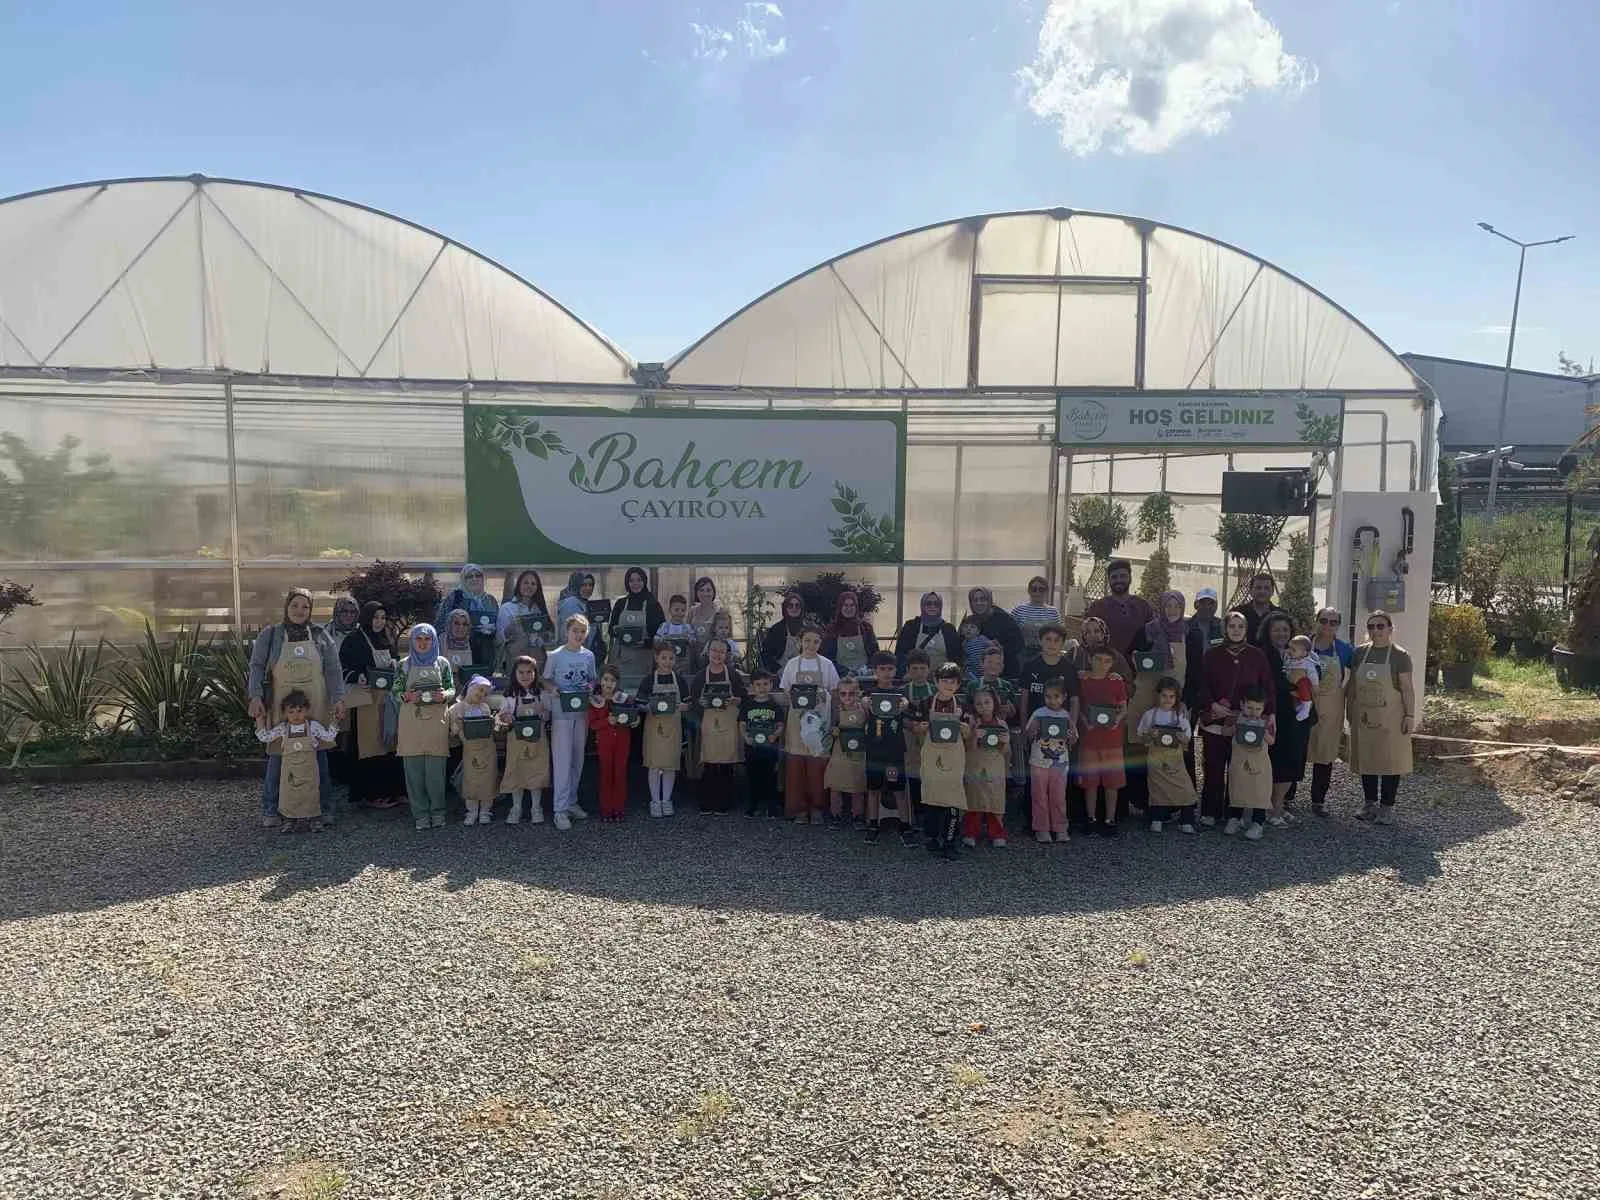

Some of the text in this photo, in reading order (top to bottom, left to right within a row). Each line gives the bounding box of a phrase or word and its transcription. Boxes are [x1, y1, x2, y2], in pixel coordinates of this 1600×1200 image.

[1128, 408, 1173, 426] HOŞ
[570, 432, 812, 497] Bahçem
[621, 499, 765, 523] ÇAYIROVA
